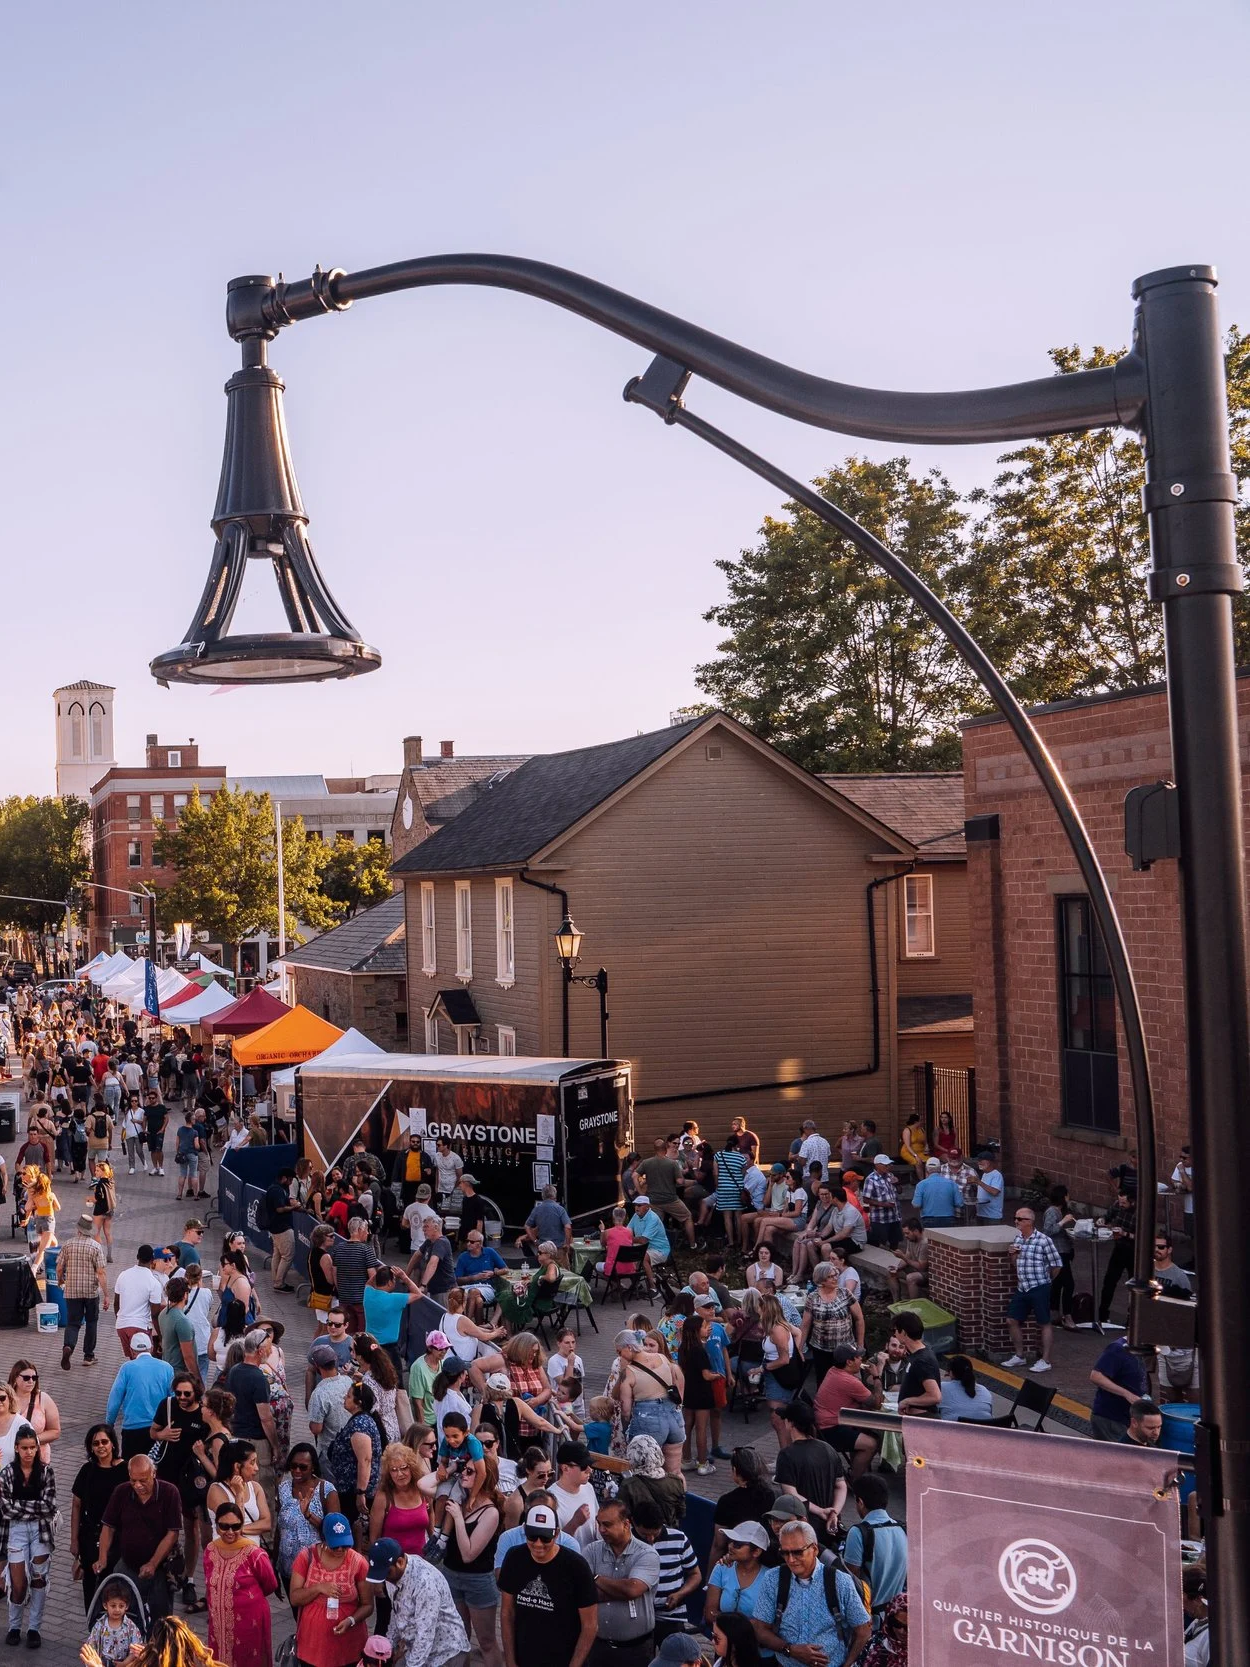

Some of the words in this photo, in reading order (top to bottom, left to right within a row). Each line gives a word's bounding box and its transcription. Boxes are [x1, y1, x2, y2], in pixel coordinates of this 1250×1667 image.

[256, 1052, 286, 1061] ORGANIC
[579, 1110, 618, 1131] GRAYSTONE
[427, 1122, 537, 1144] GRAYSTONE
[517, 1594, 538, 1604] Fred-e
[539, 1599, 554, 1608] Hack
[933, 1600, 1002, 1623] QUARTIER
[1009, 1616, 1100, 1643] HISTORIQUE
[1107, 1635, 1128, 1648] DE
[1135, 1639, 1155, 1652] LA
[953, 1618, 1130, 1667] GARNISON
